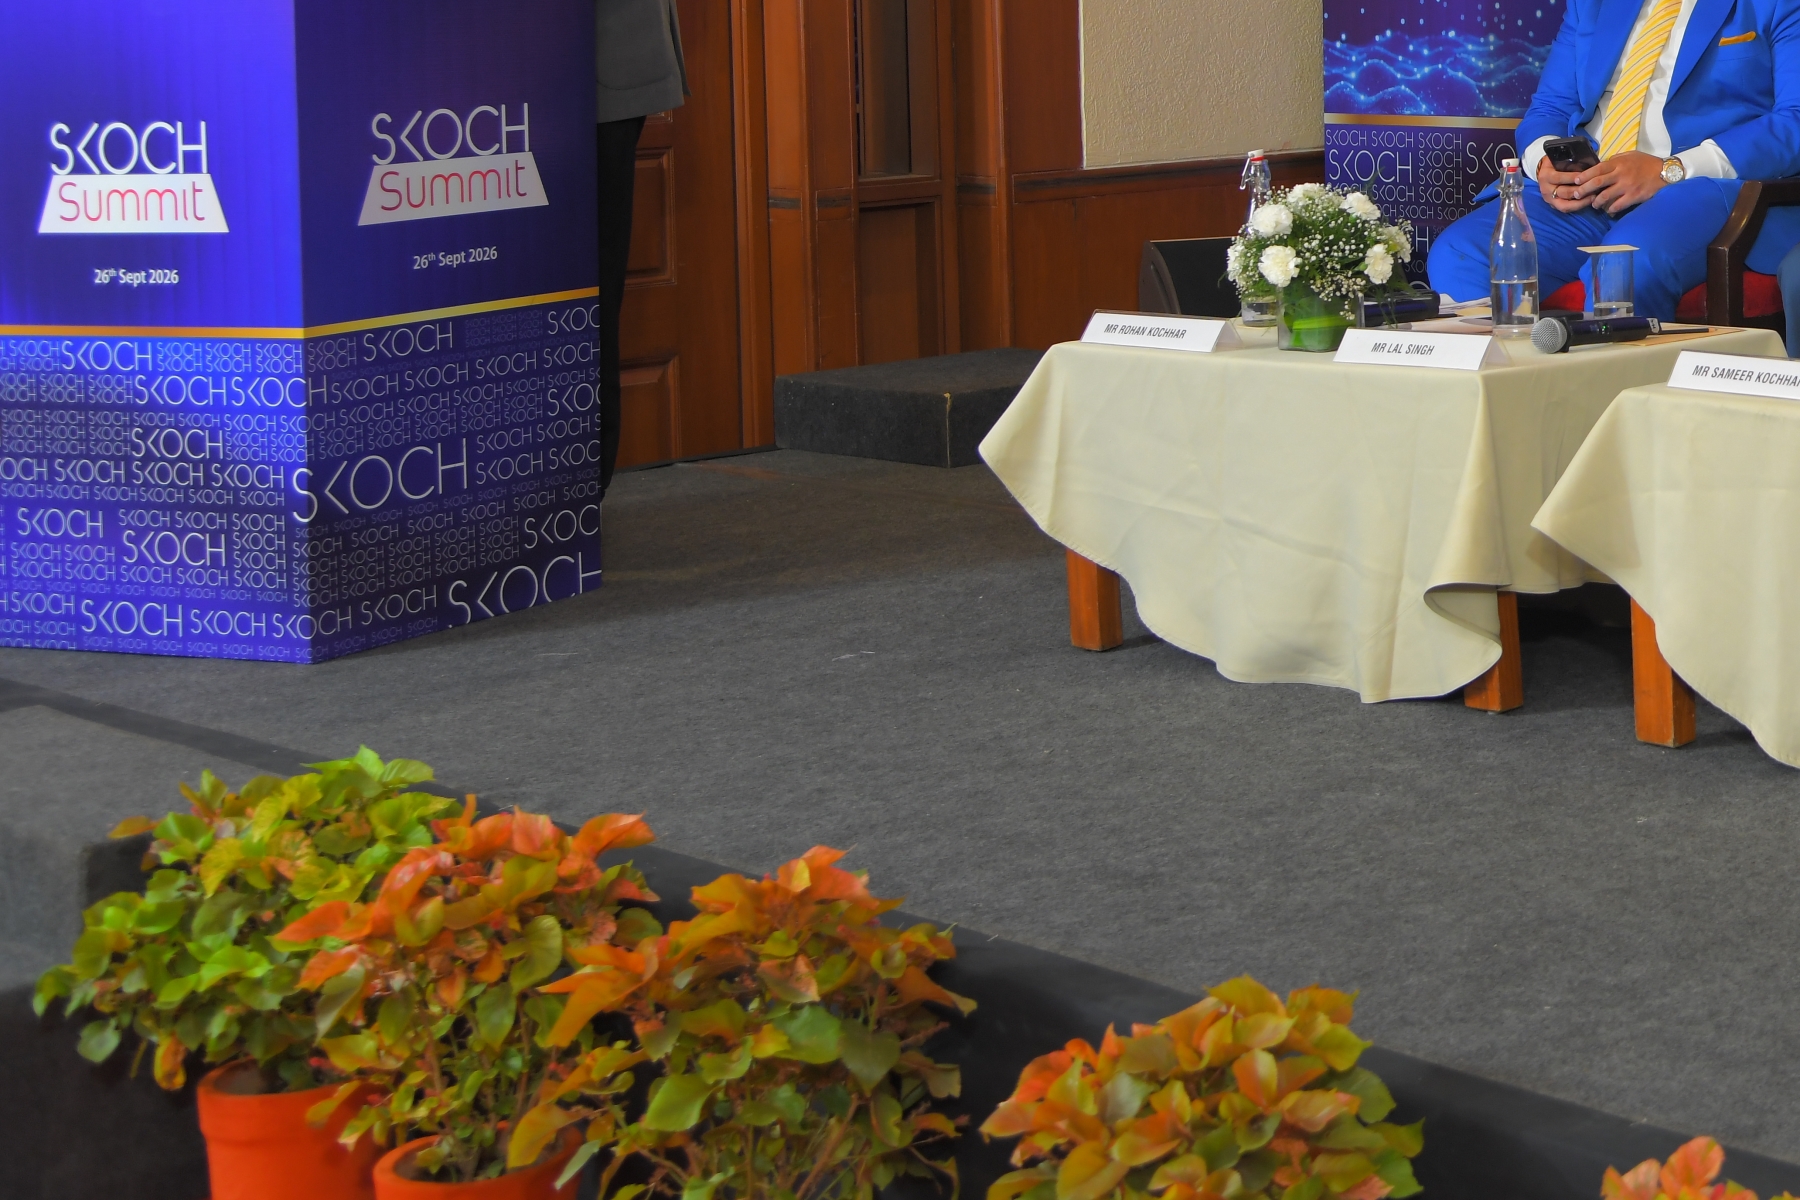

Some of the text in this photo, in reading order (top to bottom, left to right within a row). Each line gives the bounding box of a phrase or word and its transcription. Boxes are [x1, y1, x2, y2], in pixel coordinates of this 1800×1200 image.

[49, 120, 208, 175] SKOCH
[371, 102, 530, 166] SKOCH
[1325, 129, 1462, 150] SKOCH SKOCH SKOCH
[1328, 141, 1516, 183] SKOCH SKO
[1418, 150, 1463, 168] SKOCH
[379, 159, 528, 211] Summit
[1418, 168, 1463, 186] SKOCH
[58, 180, 205, 222] Summit
[1372, 184, 1415, 202] SKOCH
[1419, 186, 1463, 204] SKOCH
[1399, 204, 1434, 219] SKOCH
[413, 245, 498, 270] 26th Sept 2026
[94, 267, 180, 287] 26th Sept 2026
[363, 321, 453, 362] SKOCH
[548, 304, 600, 335] SKOC
[1103, 323, 1187, 339] MR ROHAN KOCHHAR
[9, 340, 302, 371] SKOCH SKOCH SKOCH SKOCH SKOCH
[1371, 342, 1435, 355] MR LAL SINGH
[331, 373, 399, 404] SKOCH
[404, 361, 469, 392] SKOCH
[475, 350, 537, 379] SKOCH
[1691, 364, 1711, 377] MR
[1711, 366, 1754, 382] SAMEER
[135, 374, 327, 408] SKOCH SKOCH
[223, 369, 586, 433] SKOCH SKOCH SKOCH SKOCH SKOCH SKOCH SKOCH
[131, 427, 223, 459] SKOCH
[55, 458, 285, 489] SKOCH SKOCH SKOCH
[293, 415, 590, 523] SKOCH SKOCH SKOCH
[476, 450, 544, 485] SKOCH
[17, 506, 285, 538] SKOCH SKOCH SKOCH SKOCH
[524, 504, 599, 549] SKOC
[122, 530, 286, 567] SKOCH SKOCH
[11, 591, 76, 615] SKOCH
[81, 584, 437, 640] SKOCH SKOCH SKOCH SKOCH
